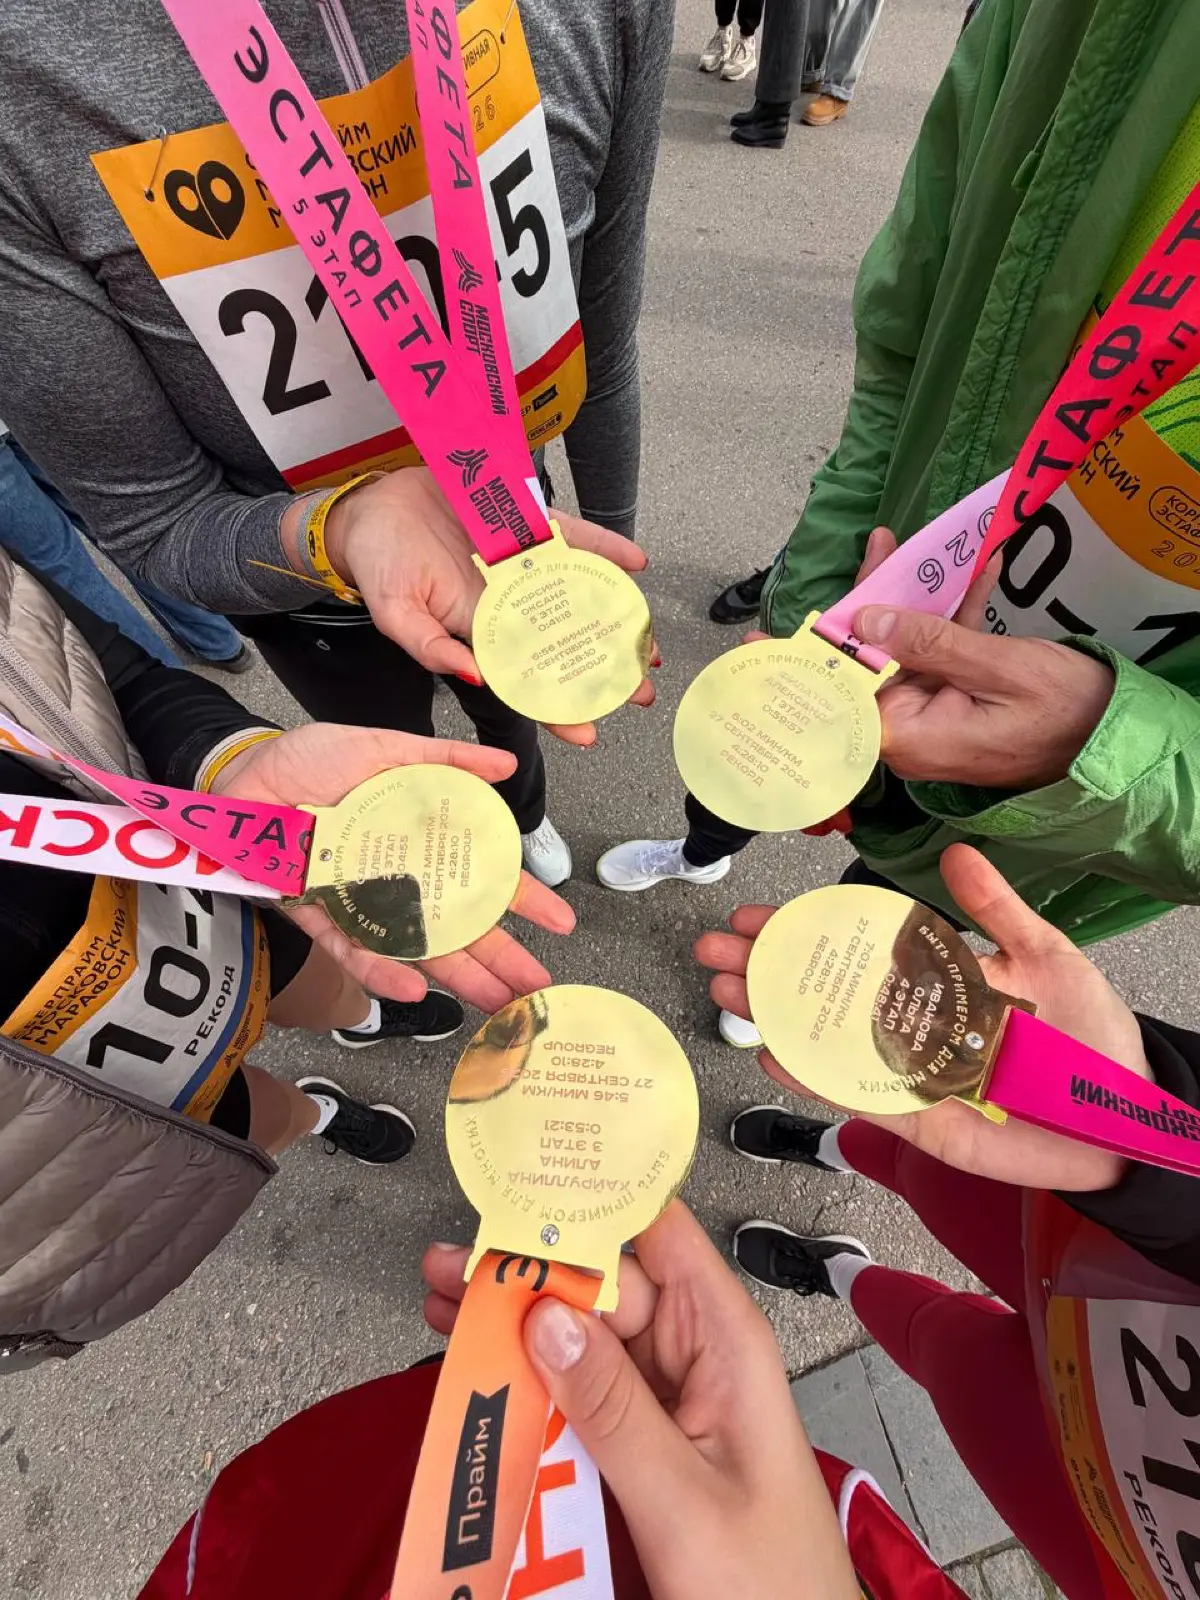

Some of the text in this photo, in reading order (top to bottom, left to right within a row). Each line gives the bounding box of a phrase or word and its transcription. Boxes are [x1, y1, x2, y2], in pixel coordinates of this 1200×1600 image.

[235, 25, 448, 399] ЭСТАФЕТА
[292, 198, 363, 309] 5 ЭТАП
[460, 299, 481, 357] СПОРТ
[474, 304, 510, 416] МОСКОВСКИЙ
[469, 486, 507, 535] СПОРТ
[1151, 539, 1200, 576] 20
[520, 589, 566, 615] ОКСАНА
[539, 600, 569, 618] ЭТАП
[536, 638, 592, 669] СЕНТЯБРЯ
[778, 700, 810, 724] ЭТАП
[722, 722, 781, 765] СЕНТЯБРЯ
[780, 764, 811, 788] 2026
[755, 731, 803, 766] МИН/КМ
[718, 750, 765, 784] РЕКОРД
[234, 849, 249, 864] 2
[384, 833, 396, 868] ЭТАП
[422, 816, 436, 868] МИН/КМ
[431, 797, 450, 920] 27 СЕНТЯБРЯ 2026
[446, 834, 460, 879] 4:28:10
[458, 828, 475, 888] REGROUP
[357, 913, 388, 938] БЫТЬ
[918, 925, 950, 959] БЫТЬ
[22, 908, 126, 1040] МОСКОВСКИЙ
[797, 935, 828, 994] REGROUP
[809, 916, 867, 1041] 27 СЕНТЯБРЯ 2026
[814, 948, 838, 993] 4:28:10
[35, 949, 131, 1045] МАРАФОН
[832, 941, 874, 1027] 7:03 МИН/КМ
[883, 976, 911, 1029] 4 ЭТАП
[898, 986, 926, 1034] ОЛЬГА
[908, 982, 947, 1052] ИВАНОВА
[946, 963, 969, 1046] ПРИМЕРОМ
[543, 1041, 616, 1054] REGROUP
[551, 1056, 605, 1069] 4:28:10
[927, 1045, 954, 1075] ДЛЯ
[522, 1085, 629, 1103] 5:46 МИН/КМ
[546, 1071, 629, 1086] СЕНТЯБРЯ
[634, 1078, 654, 1088] 27
[540, 1137, 603, 1152] 3 ЭТАП
[544, 1120, 601, 1134] 0:53:21
[539, 1155, 600, 1170] АЛИНА
[500, 1186, 536, 1212] ДЛЯ
[508, 1172, 630, 1191] ХАЙРУЛЛИНА
[539, 1190, 636, 1223] ПРИМЕРОМ
[457, 1416, 492, 1545] Прайм
